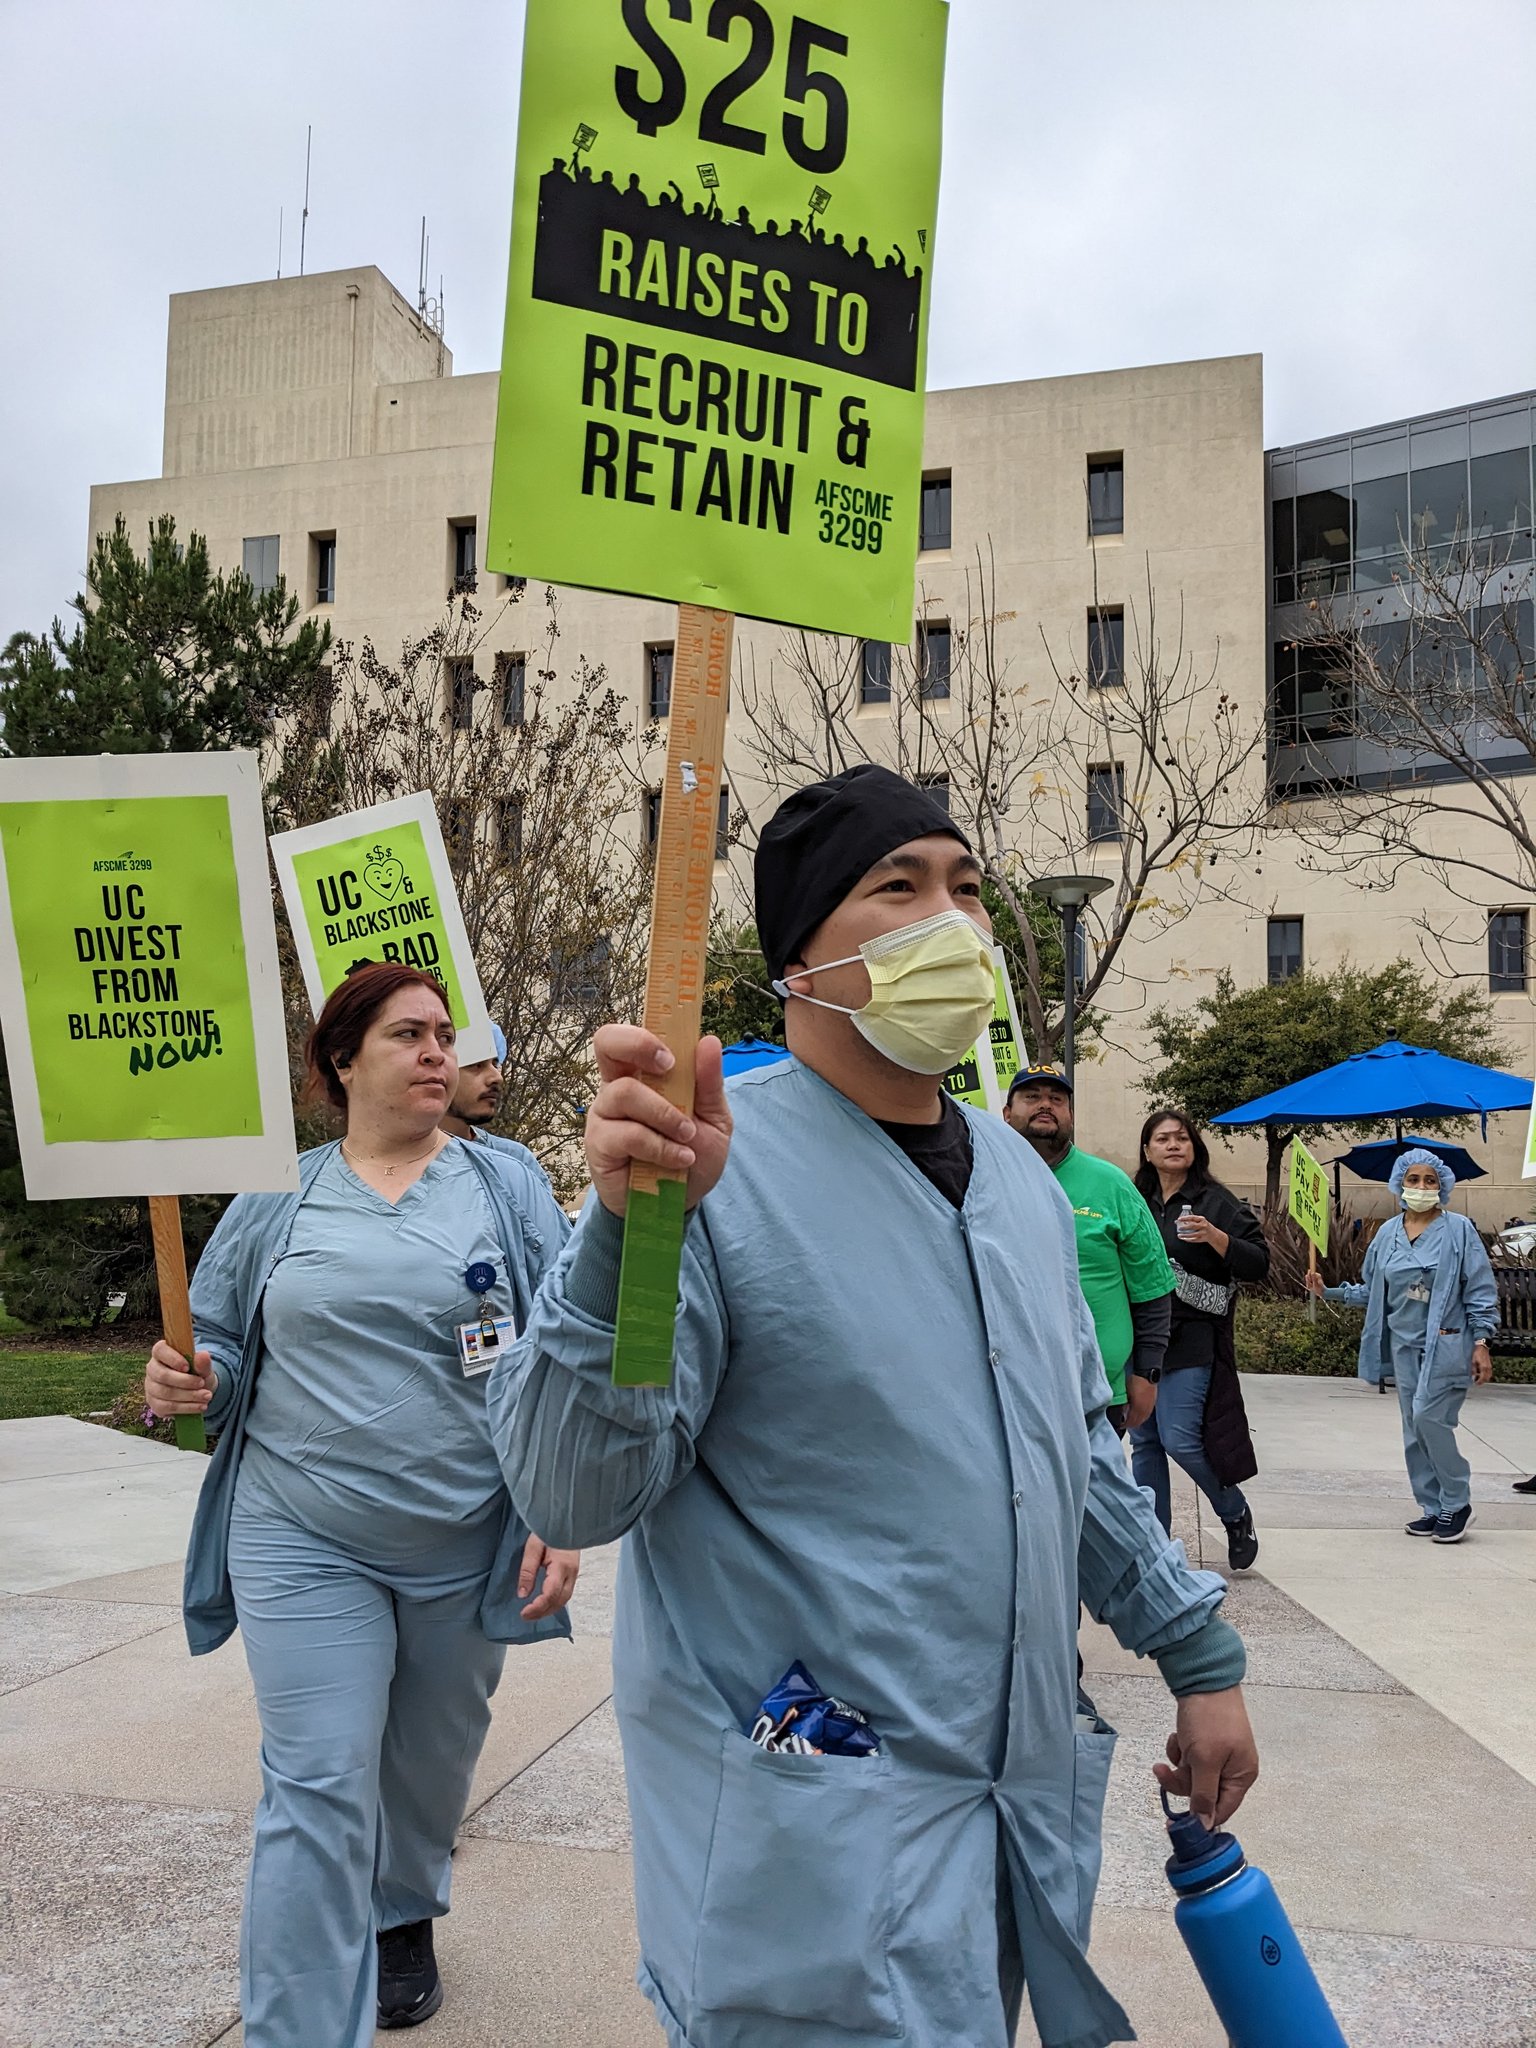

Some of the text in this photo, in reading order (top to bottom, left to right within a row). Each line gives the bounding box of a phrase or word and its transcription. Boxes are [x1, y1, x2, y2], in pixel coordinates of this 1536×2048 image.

[615, 0, 849, 175] $25
[600, 229, 868, 357] RAISES TO
[581, 334, 871, 469] RECRUIT &
[581, 421, 795, 536] RETAIN
[815, 479, 893, 523] AFSCME
[818, 510, 884, 556] 3299
[705, 626, 726, 698] HOME
[93, 859, 152, 872] AFSCME 3299
[677, 757, 715, 1007] THE HOME DEPOT
[102, 884, 146, 921] UC
[316, 870, 414, 917] UC &
[74, 925, 183, 962] DIVEST
[324, 896, 434, 947] BLACKSTONE
[382, 931, 440, 969] BAD
[92, 967, 179, 1004] FROM
[68, 1009, 215, 1040] BLACKSTONE
[129, 1023, 223, 1076] NOW!
[947, 1073, 966, 1091] TO
[1296, 1151, 1306, 1172] UC
[1296, 1166, 1310, 1192] PAY
[1304, 1199, 1321, 1227] RENT
